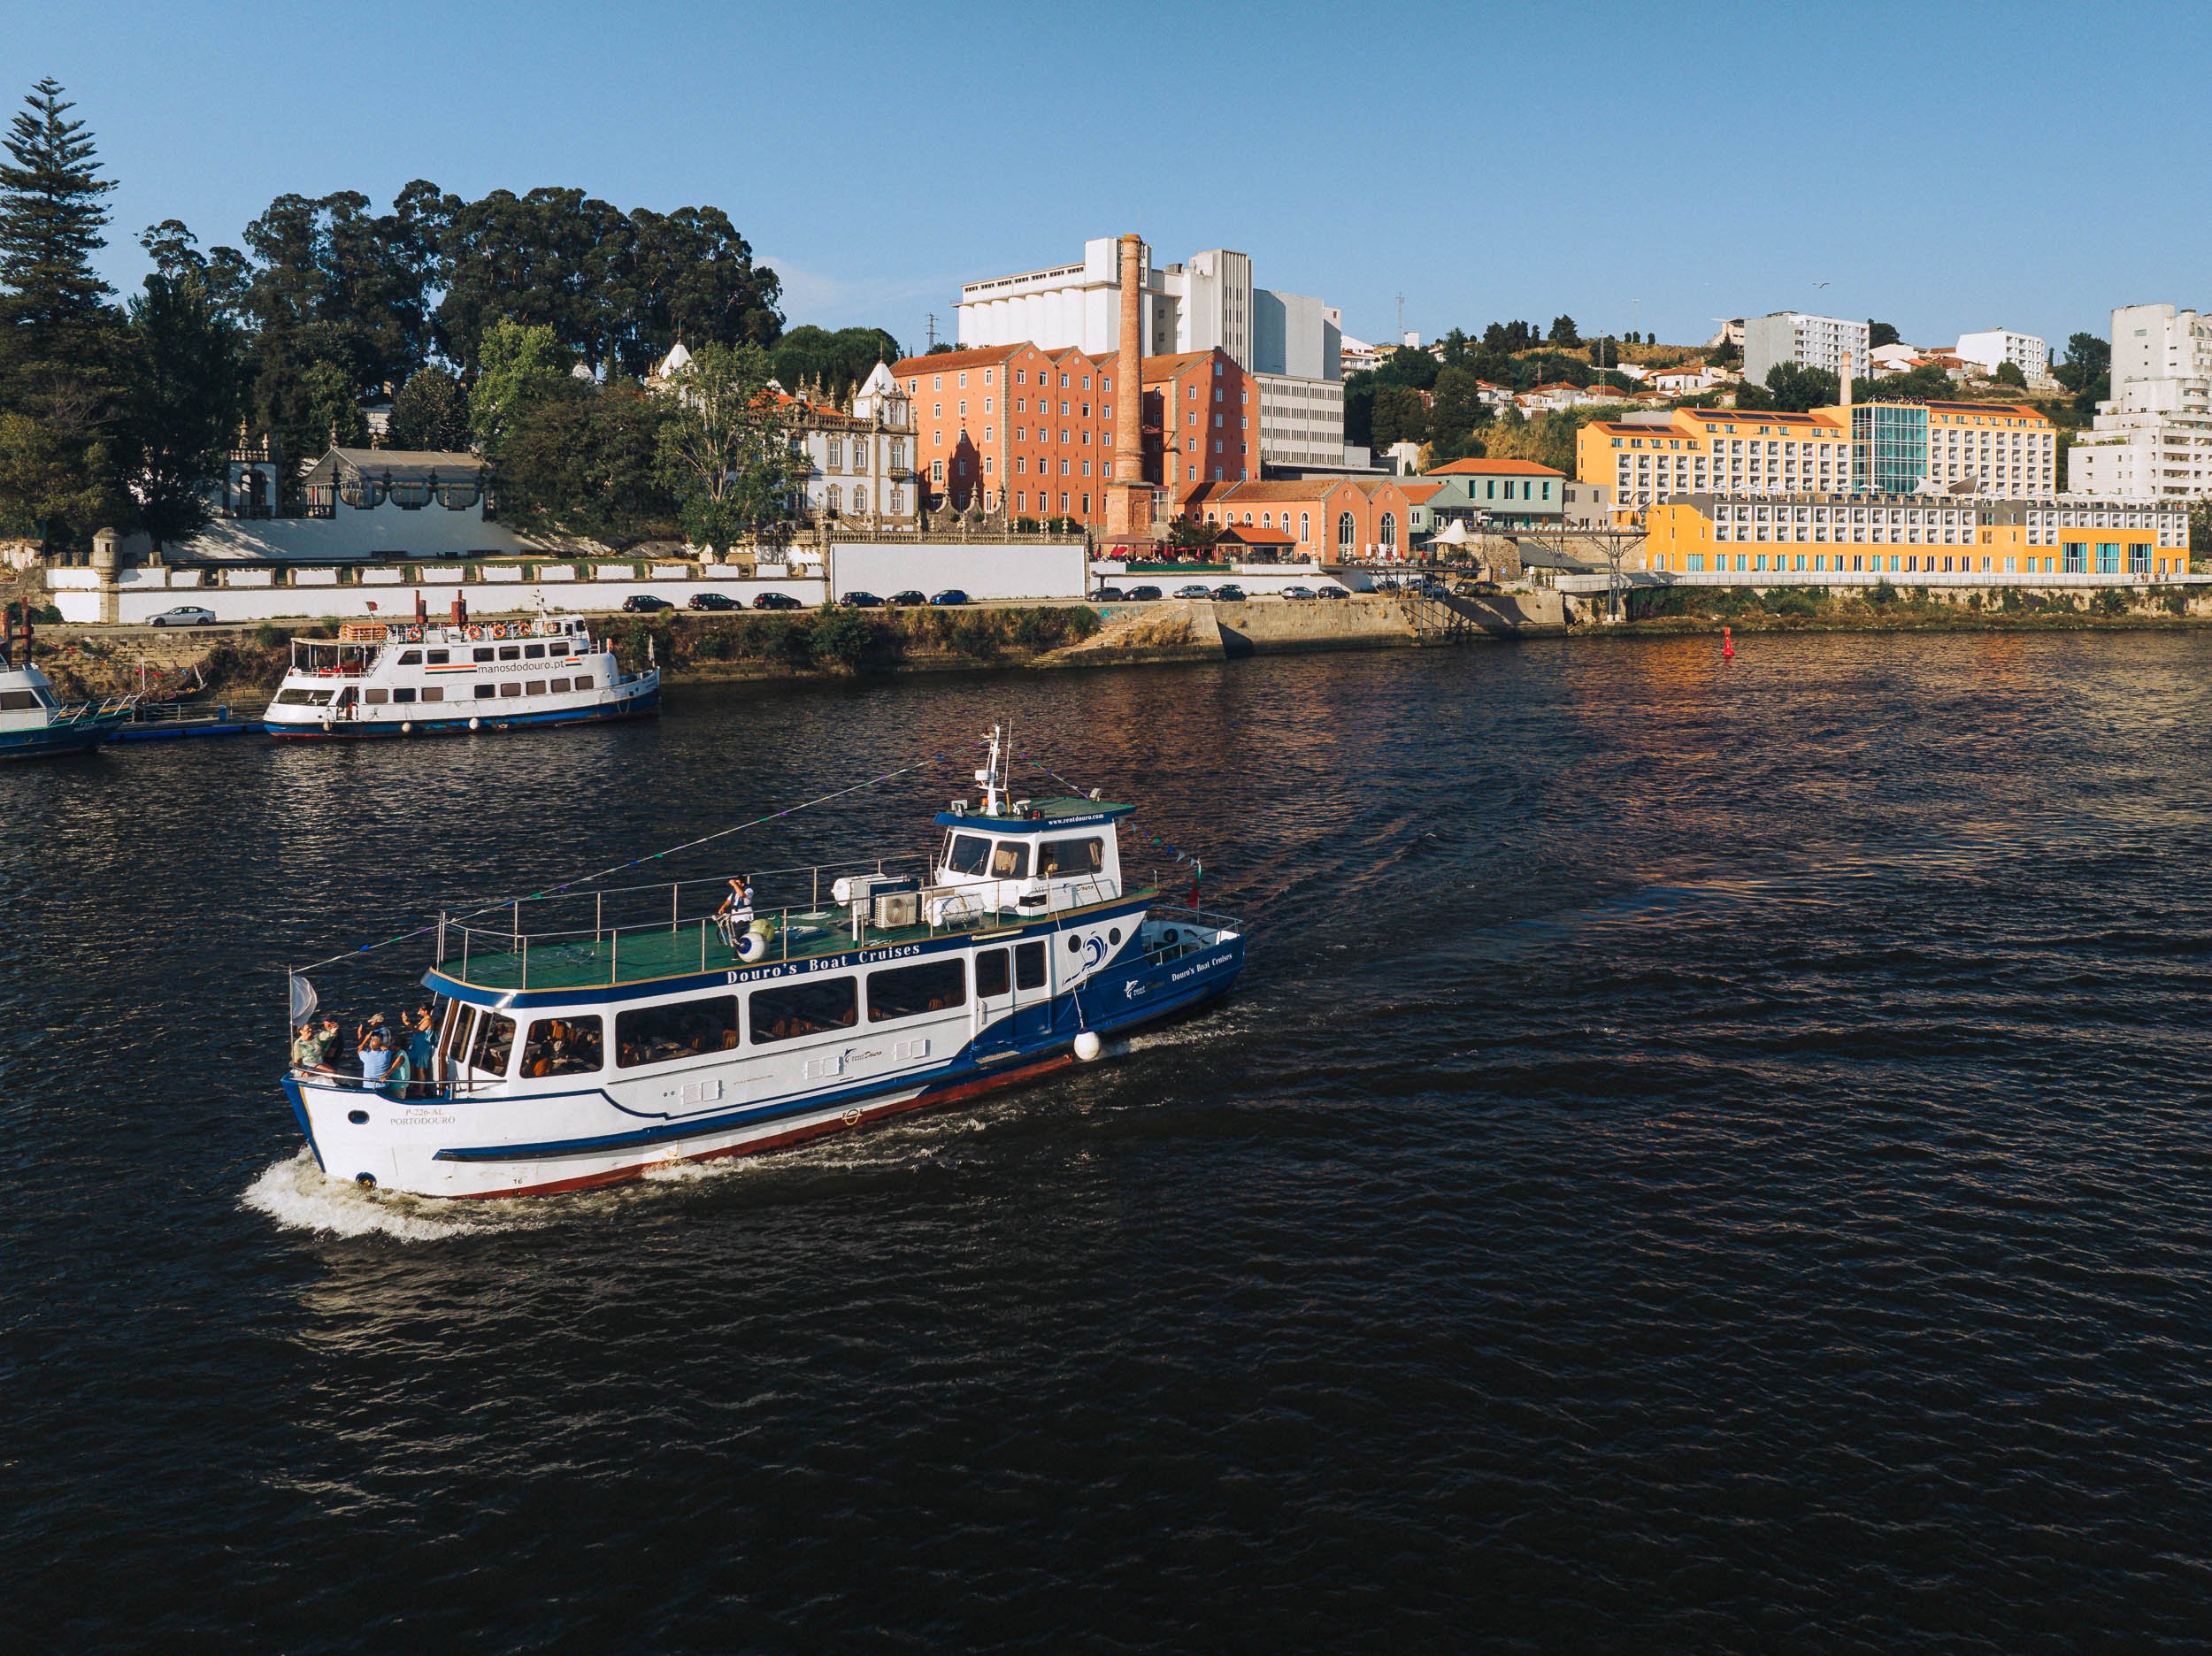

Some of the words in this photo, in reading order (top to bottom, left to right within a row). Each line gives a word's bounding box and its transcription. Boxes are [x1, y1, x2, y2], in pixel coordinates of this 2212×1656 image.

[478, 660, 565, 673] manosdodouro.pt
[1048, 813, 1104, 825] www.rentdouro.com
[726, 962, 797, 985] Douro's
[809, 955, 848, 971] Boat
[858, 944, 920, 962] Cruises
[1171, 967, 1194, 982] Douro's
[1196, 962, 1210, 972] Boat
[1211, 953, 1233, 966] Cruises
[390, 1116, 456, 1125] PORTODOURO
